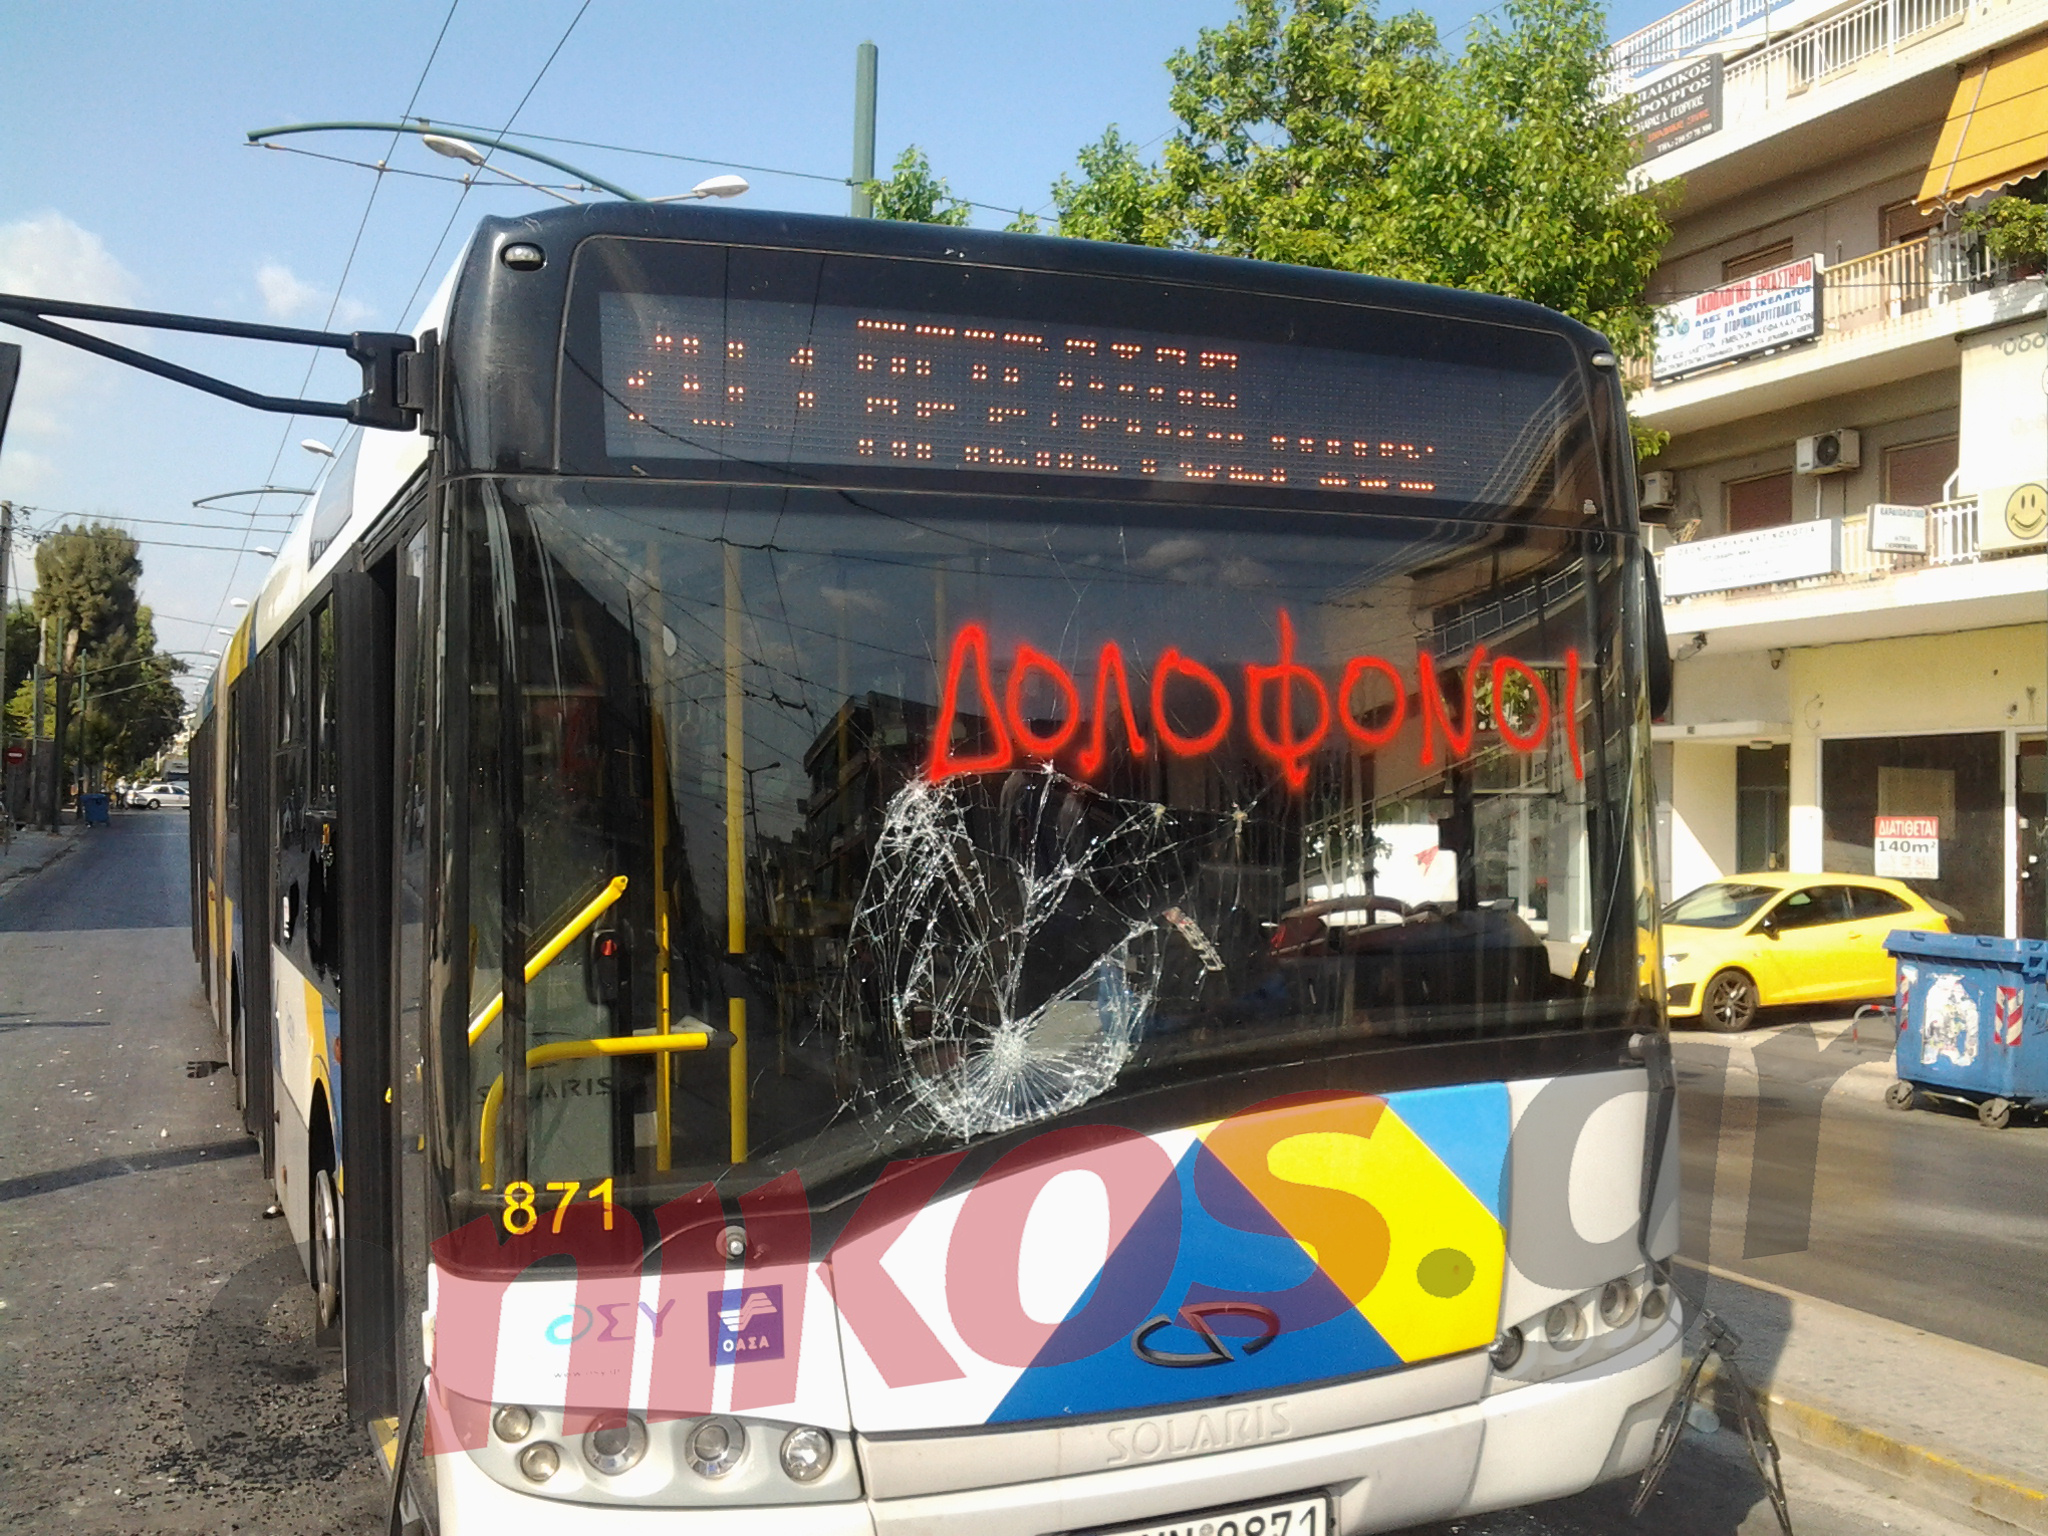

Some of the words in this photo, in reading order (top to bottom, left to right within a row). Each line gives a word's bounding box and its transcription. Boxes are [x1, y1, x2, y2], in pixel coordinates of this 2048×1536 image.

[1756, 261, 1812, 297] ΕΡΓΑΣΤΗΡΙΟ
[925, 608, 1585, 792] ΔΟΛΟΦΟΝΟΙ
[1879, 820, 1936, 837] ΔΙΑΤΙΘΕΤΑΙ
[476, 1077, 612, 1105] SARIS
[502, 1178, 615, 1235] 871
[1106, 1402, 1294, 1465] SOLARIS
